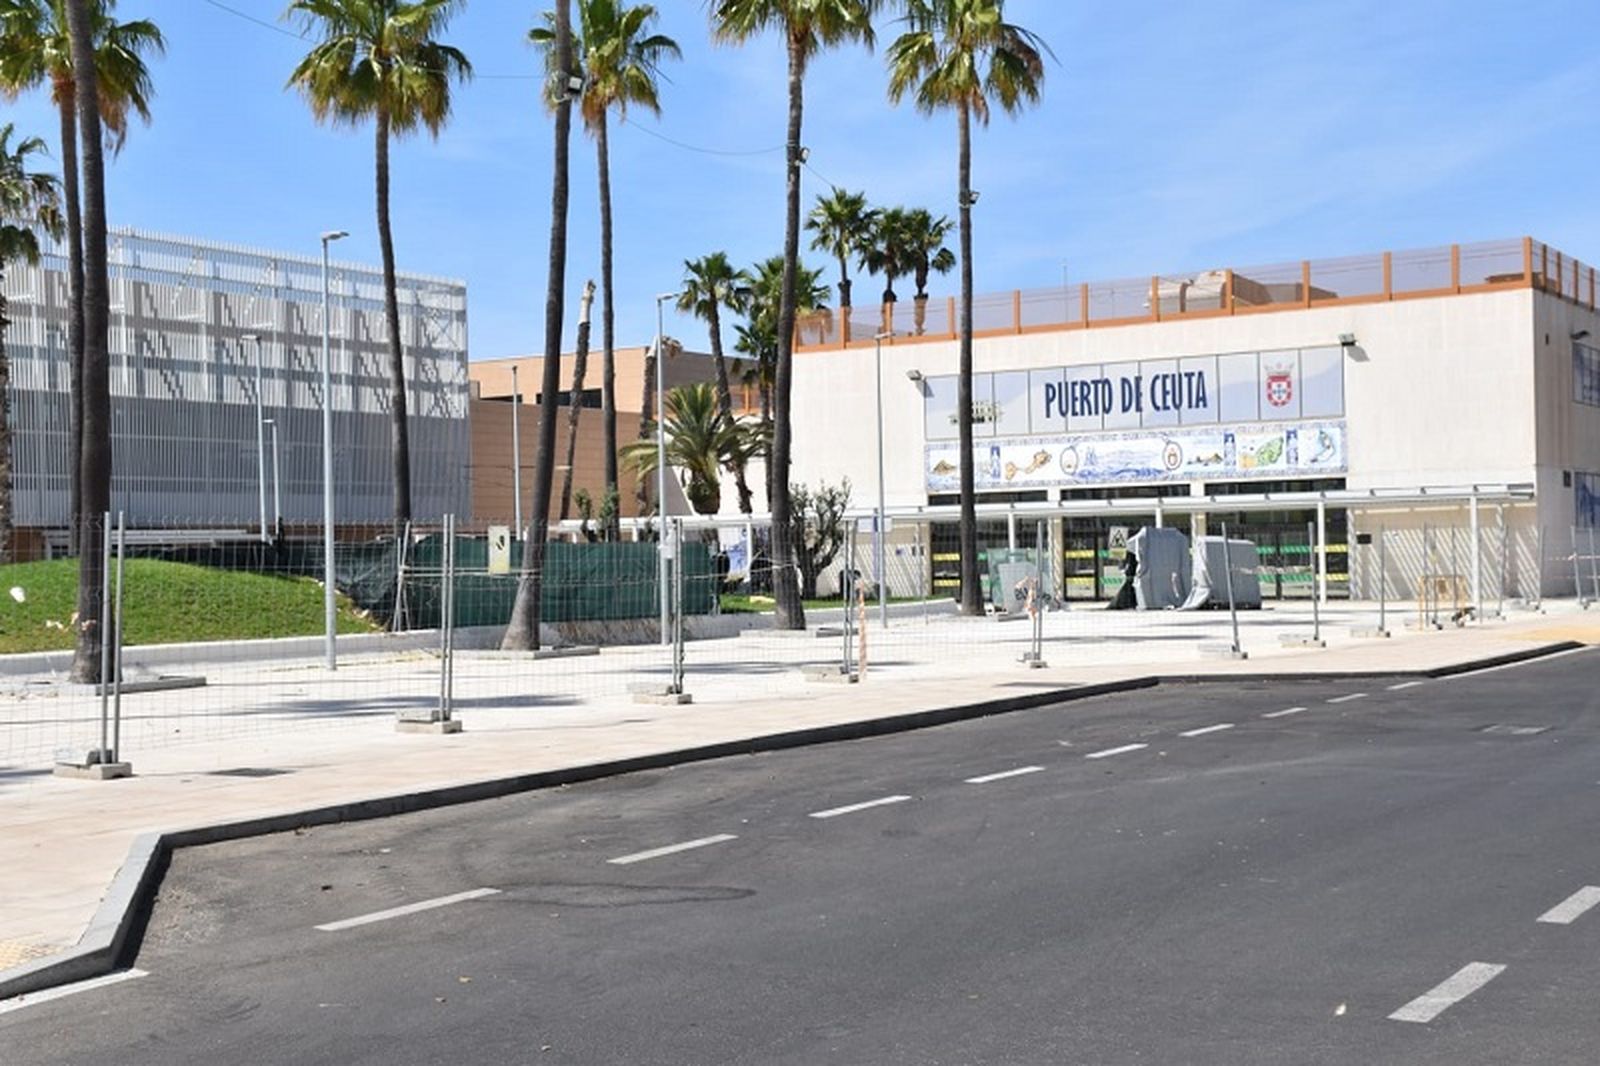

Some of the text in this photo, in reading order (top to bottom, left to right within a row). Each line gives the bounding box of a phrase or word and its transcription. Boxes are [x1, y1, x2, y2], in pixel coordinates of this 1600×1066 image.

[1045, 371, 1207, 418] PUERTO DE CEUTA
